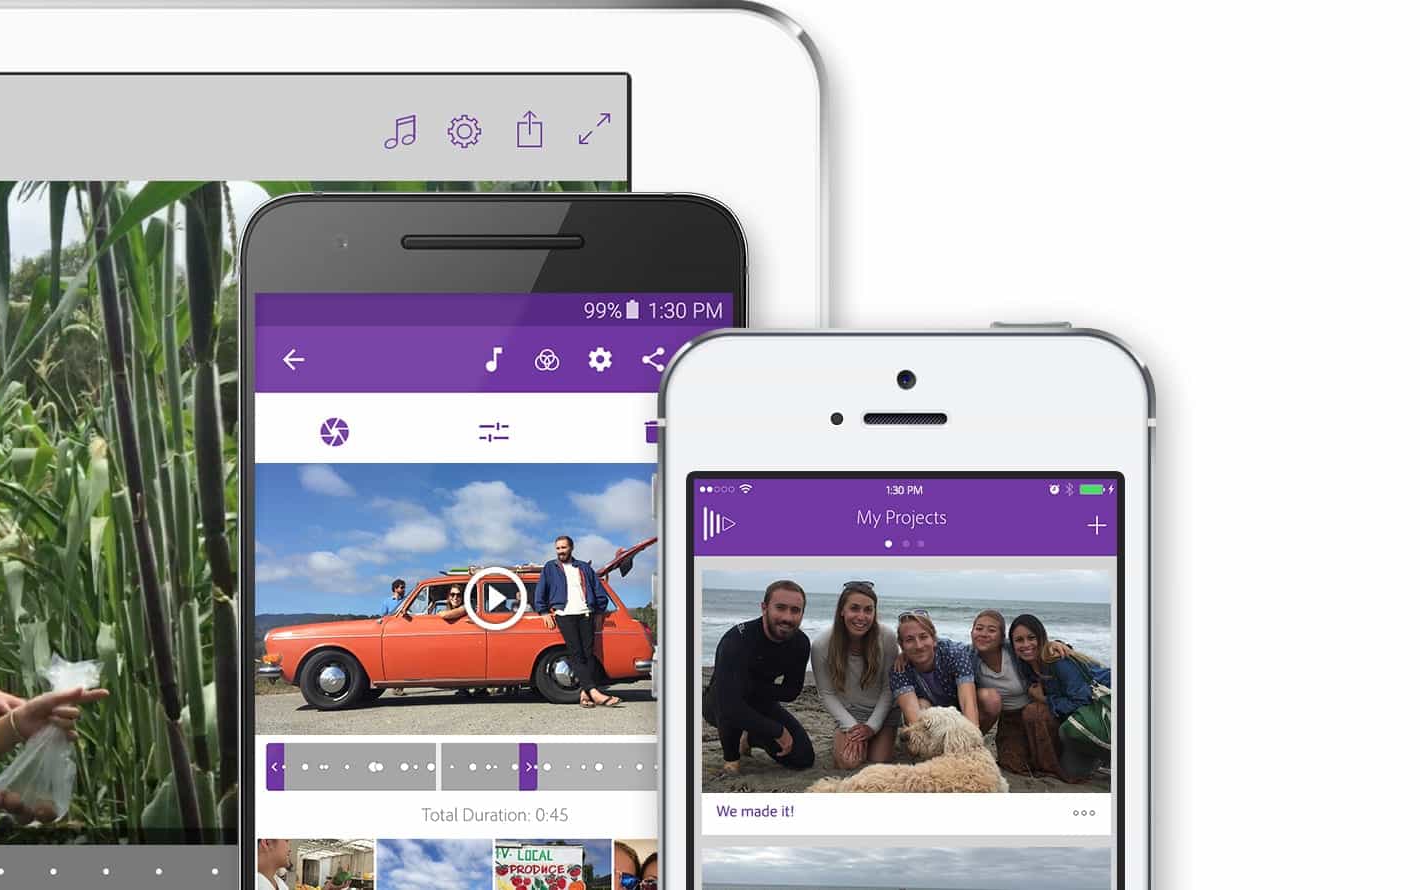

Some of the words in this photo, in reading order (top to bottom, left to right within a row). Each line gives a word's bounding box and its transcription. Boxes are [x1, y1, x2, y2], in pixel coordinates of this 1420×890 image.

[583, 301, 623, 320] 99%
[648, 301, 687, 320] 1:30
[692, 301, 723, 320] PM
[885, 484, 905, 496] 1:30
[907, 484, 924, 496] PM
[857, 509, 882, 529] My
[886, 509, 948, 529] Projects
[421, 806, 458, 823] Total
[462, 806, 531, 823] Duration:
[535, 806, 569, 823] 0:45
[716, 804, 738, 818] We
[740, 804, 778, 818] made
[781, 804, 795, 818] it!
[517, 848, 554, 861] LOCAL
[509, 863, 565, 874] PRODUCE
